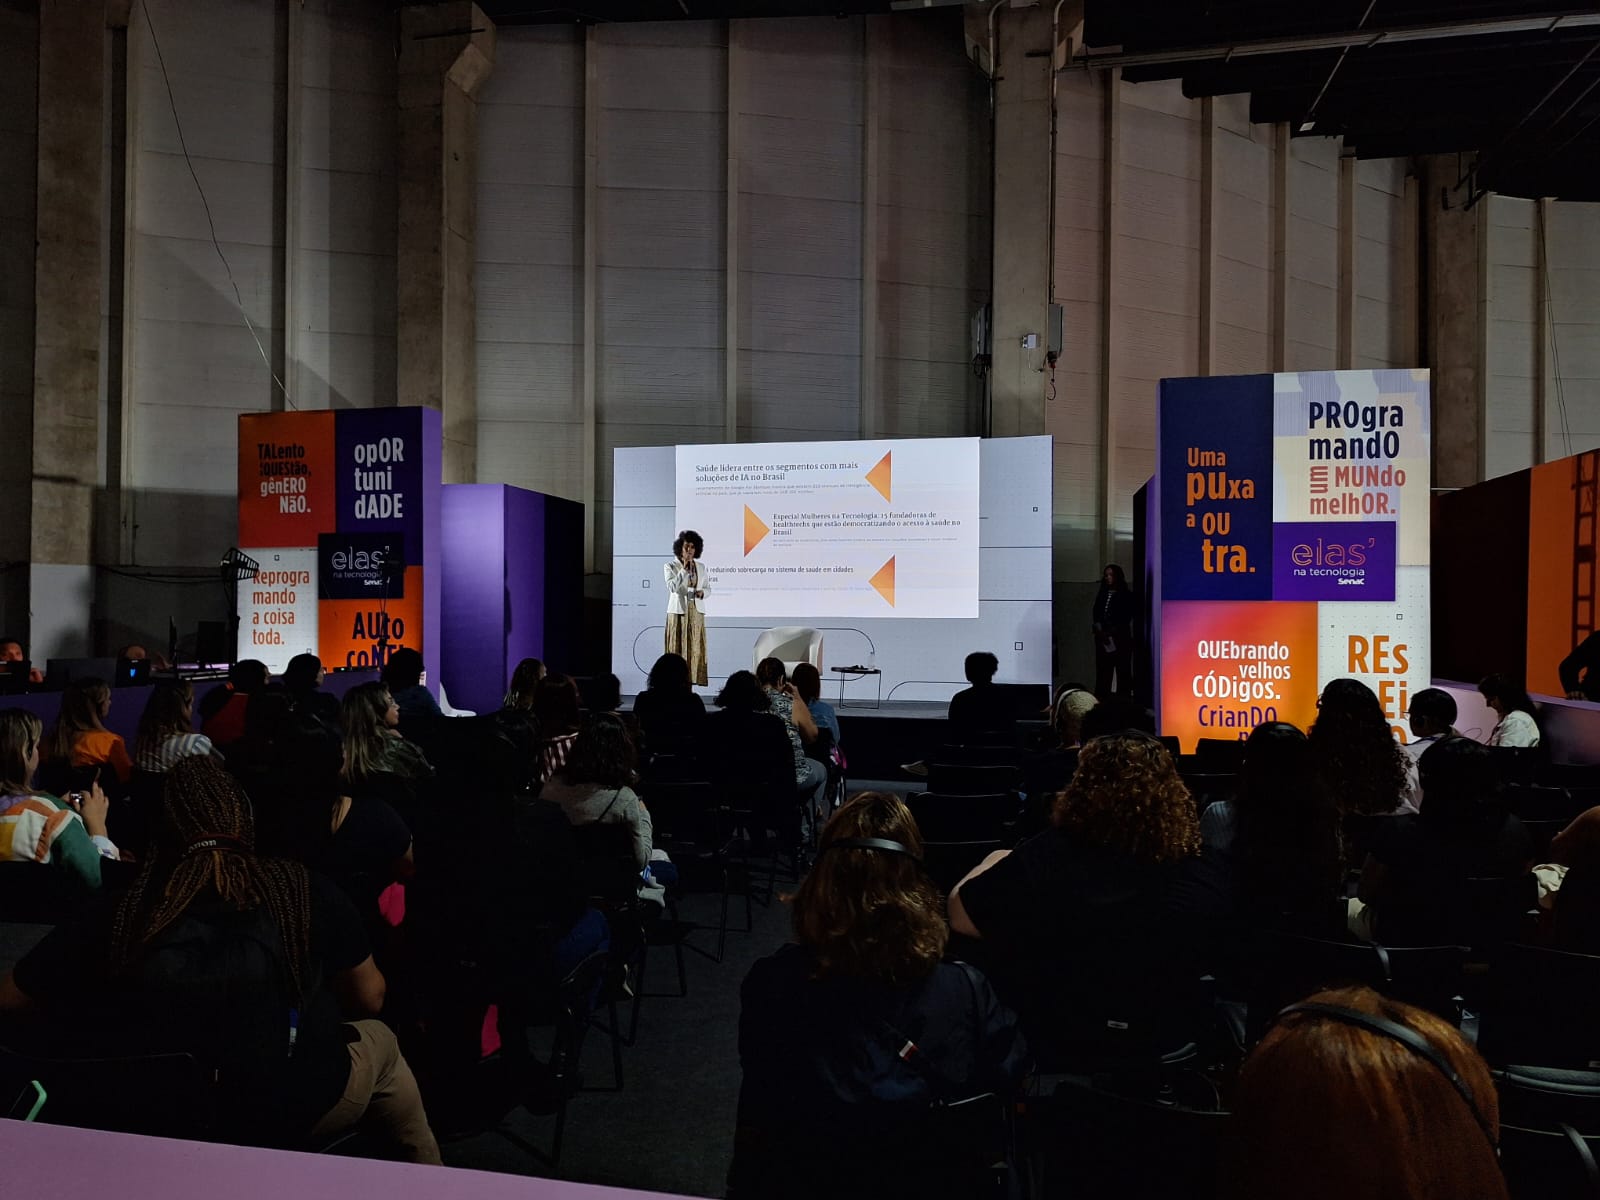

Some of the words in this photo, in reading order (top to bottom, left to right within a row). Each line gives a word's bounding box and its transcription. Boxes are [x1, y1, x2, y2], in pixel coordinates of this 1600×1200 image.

[1308, 400, 1404, 432] PROgra
[257, 443, 305, 460] TALento
[354, 437, 404, 467] opOR
[1308, 430, 1400, 460] mandO
[1187, 447, 1226, 467] Uma
[695, 464, 718, 473] Saúde
[743, 464, 764, 472] entre
[775, 462, 819, 473] segmentos
[820, 462, 838, 470] com
[839, 461, 859, 470] mais
[260, 477, 306, 497] gênERO
[354, 466, 392, 491] tuni
[695, 473, 728, 485] soluções
[729, 473, 739, 482] de
[740, 473, 750, 482] IA
[762, 472, 785, 481] Brasil
[1310, 465, 1328, 494] um
[1335, 464, 1406, 487] MUNdo
[1186, 471, 1255, 506] puxa
[279, 495, 312, 514] NãO.
[354, 493, 404, 519] dADE
[1309, 492, 1397, 515] melhOR.
[773, 512, 800, 521] Especial
[800, 512, 831, 521] Mulheres
[928, 511, 937, 519] de
[811, 520, 823, 530] que
[824, 519, 842, 528] estão
[842, 519, 895, 528] democratizando
[896, 520, 902, 528] o
[902, 519, 925, 527] acesso
[951, 518, 961, 526] no
[1186, 513, 1196, 527] a
[773, 528, 792, 537] Brasil
[1202, 538, 1256, 573] tra.
[253, 569, 310, 588] Reprogra
[737, 565, 767, 575] sobrecarga
[775, 565, 797, 574] sistema
[797, 565, 805, 573] de
[832, 565, 854, 574] cidades
[1293, 568, 1307, 576] na
[1309, 566, 1365, 578] tecnologia
[252, 588, 296, 605] mando
[252, 612, 260, 625] a
[263, 609, 295, 625] coisa
[252, 628, 285, 646] toda.
[1197, 640, 1289, 660] QUEbrando
[1347, 635, 1409, 675] REs
[1238, 661, 1291, 680] velhos
[1192, 670, 1281, 702] CÓDigos.
